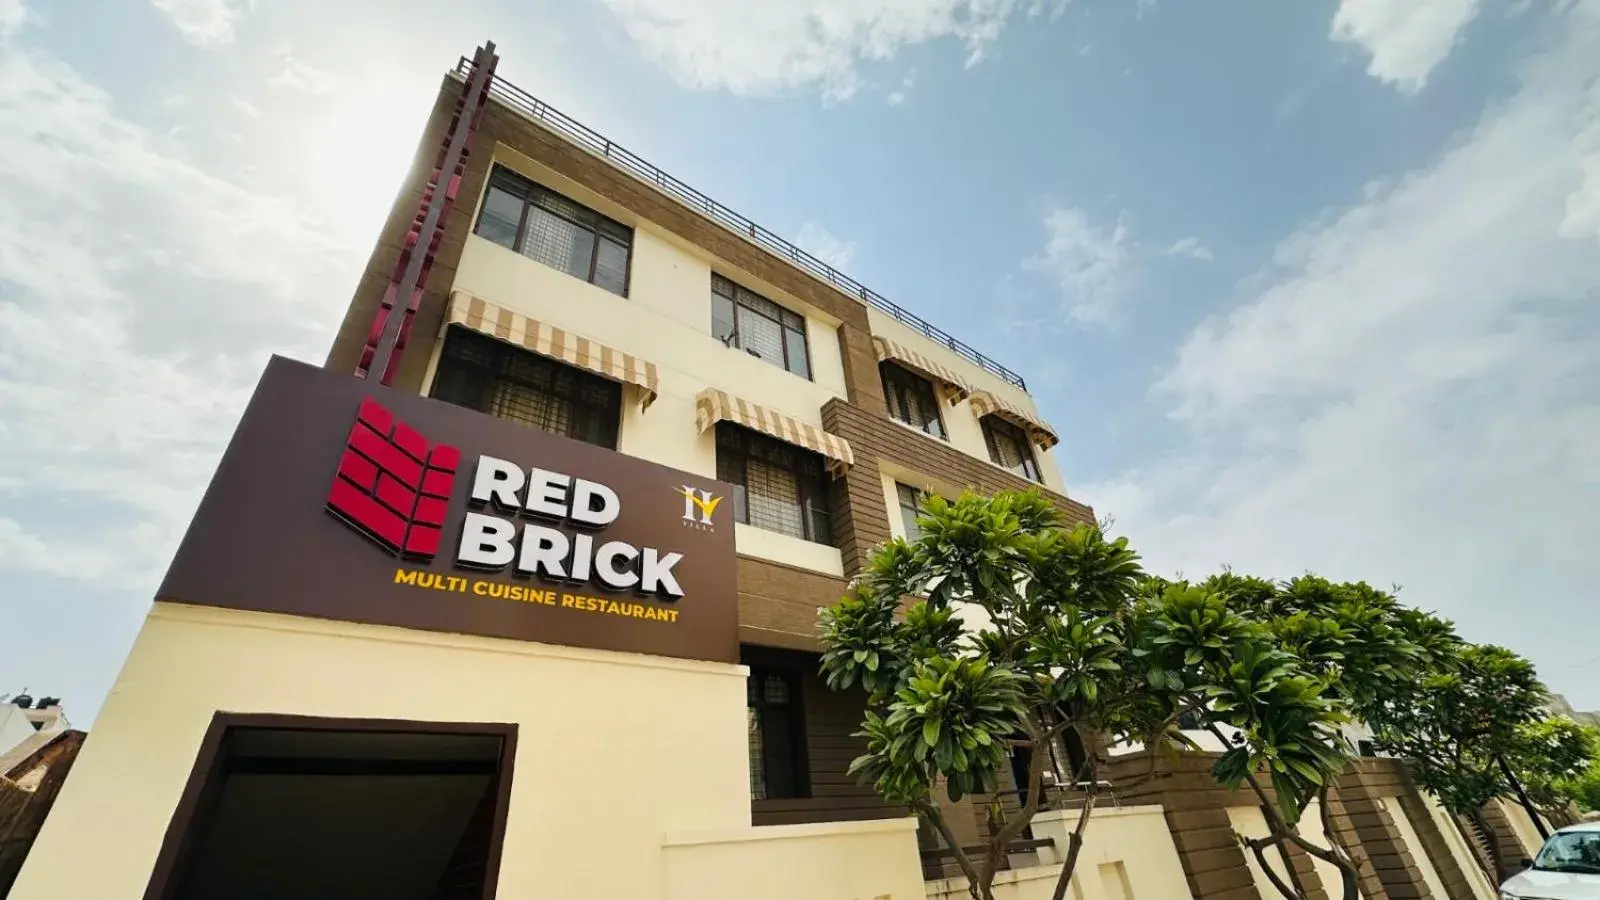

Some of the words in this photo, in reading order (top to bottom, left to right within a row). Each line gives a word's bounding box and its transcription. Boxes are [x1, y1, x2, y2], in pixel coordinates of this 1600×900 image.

[471, 454, 621, 525] RED
[457, 511, 685, 597] BRICK
[394, 568, 468, 593] MULTI
[472, 580, 557, 606] CUISINE
[561, 593, 680, 623] RESTAURANT
